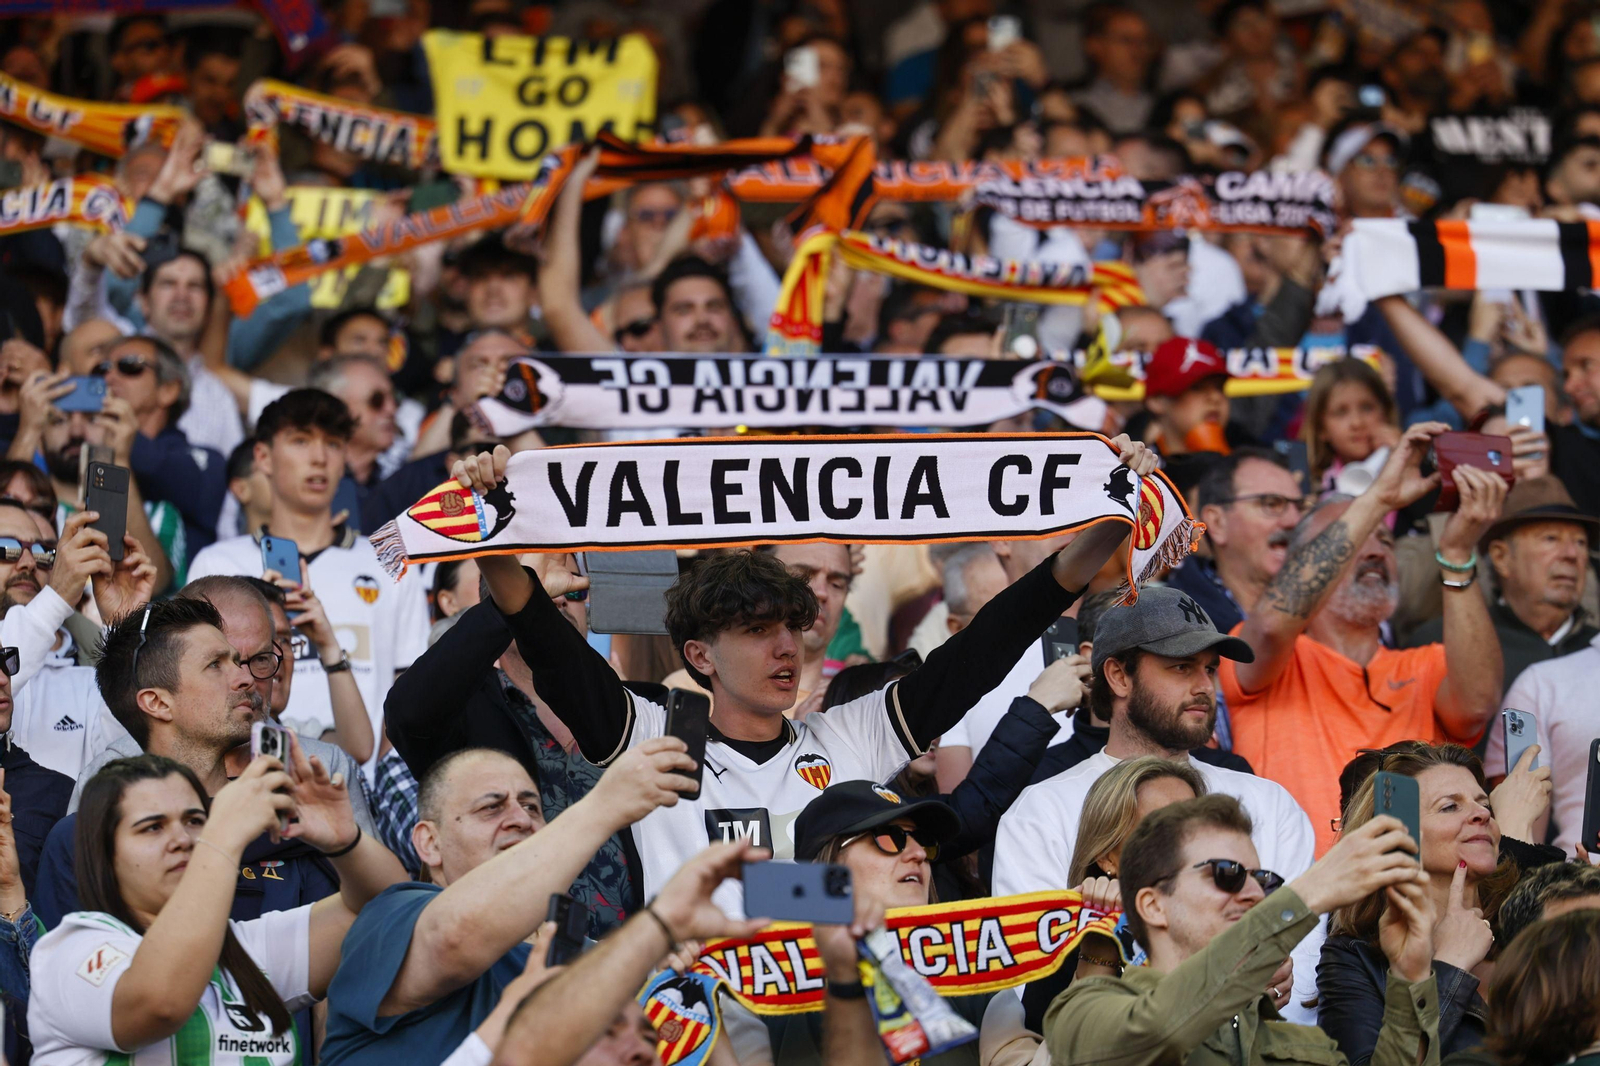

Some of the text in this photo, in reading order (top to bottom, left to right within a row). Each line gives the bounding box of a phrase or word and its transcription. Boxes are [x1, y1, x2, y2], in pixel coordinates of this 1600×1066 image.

[517, 75, 590, 107] GO
[547, 453, 1082, 527] VALENCIA CF
[700, 918, 1016, 996] VALCIA
[217, 1034, 291, 1053] finetwork
